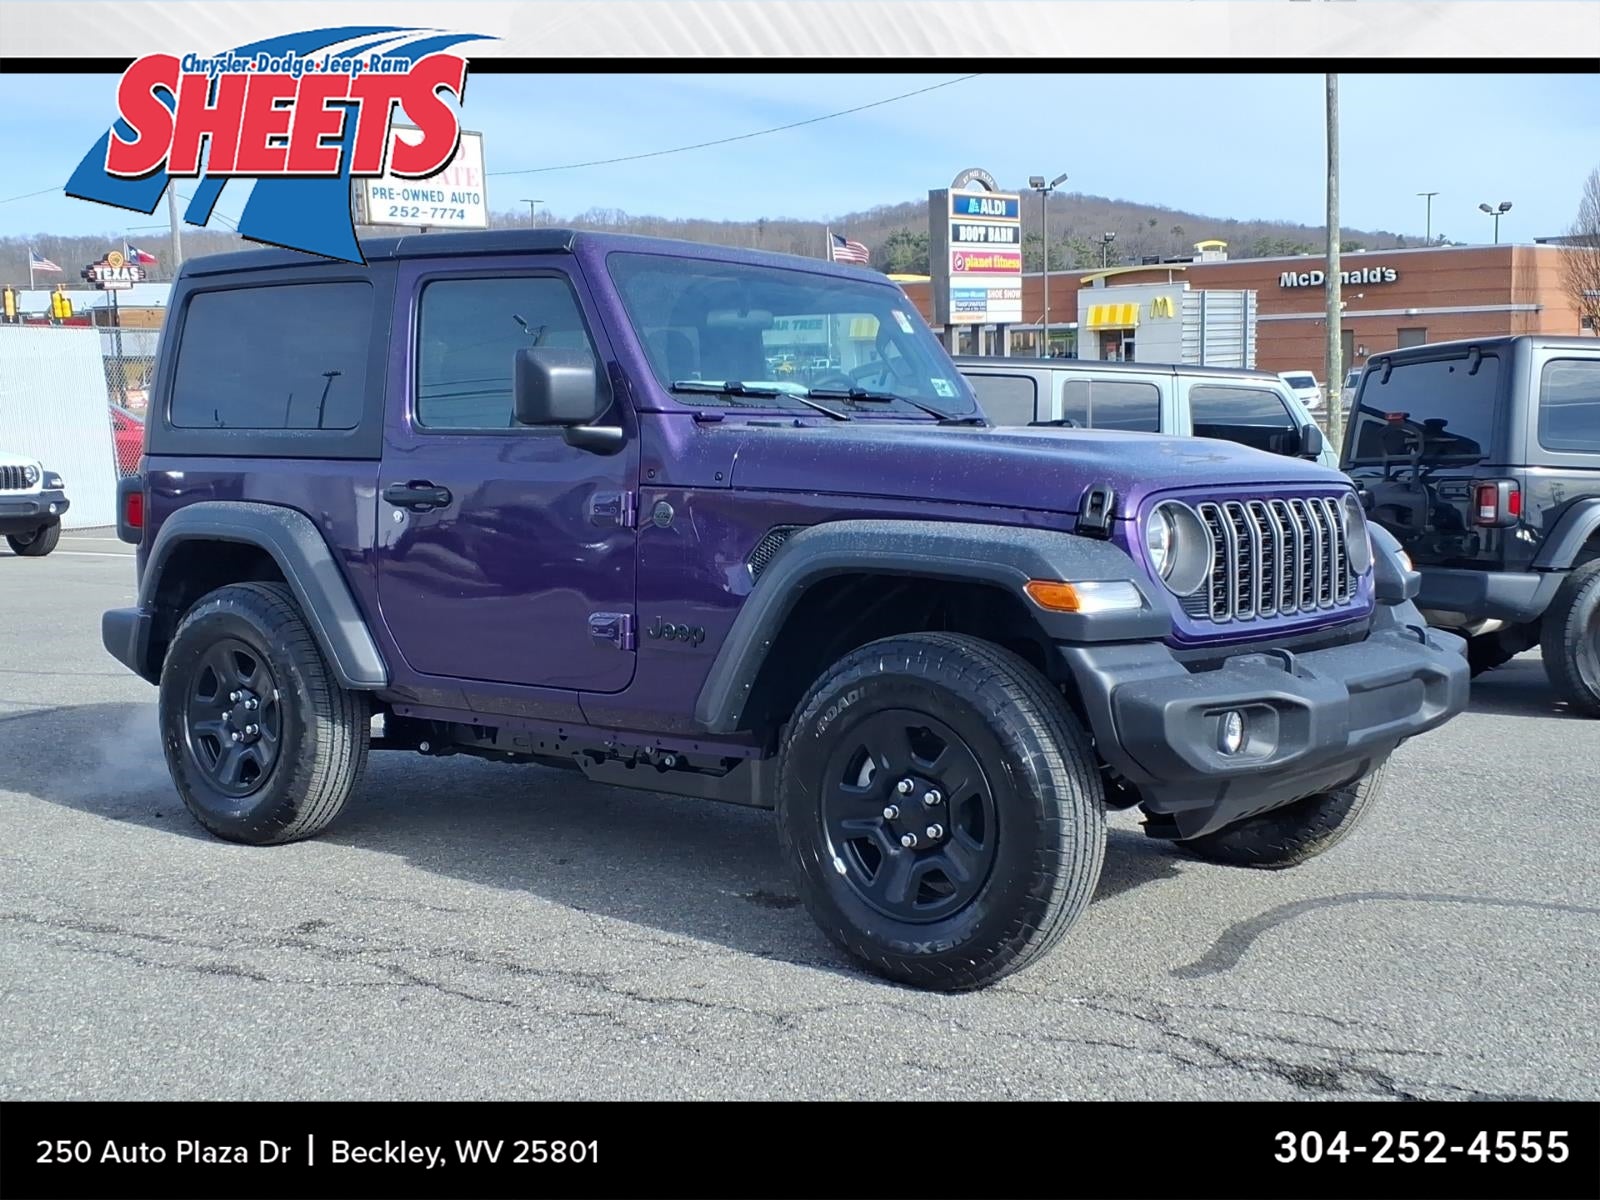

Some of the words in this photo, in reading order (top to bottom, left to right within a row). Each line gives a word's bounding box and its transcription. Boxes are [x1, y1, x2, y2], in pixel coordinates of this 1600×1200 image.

[371, 186, 445, 203] PRE-OWNED
[450, 191, 480, 205] AUTO
[388, 205, 465, 220] 252-7774
[980, 198, 1006, 216] ALDI
[959, 225, 986, 242] BOOT
[987, 226, 1014, 243] BARN
[93, 267, 140, 281] TEXAS
[1279, 266, 1398, 288] McDnald's
[647, 615, 706, 647] Jeep
